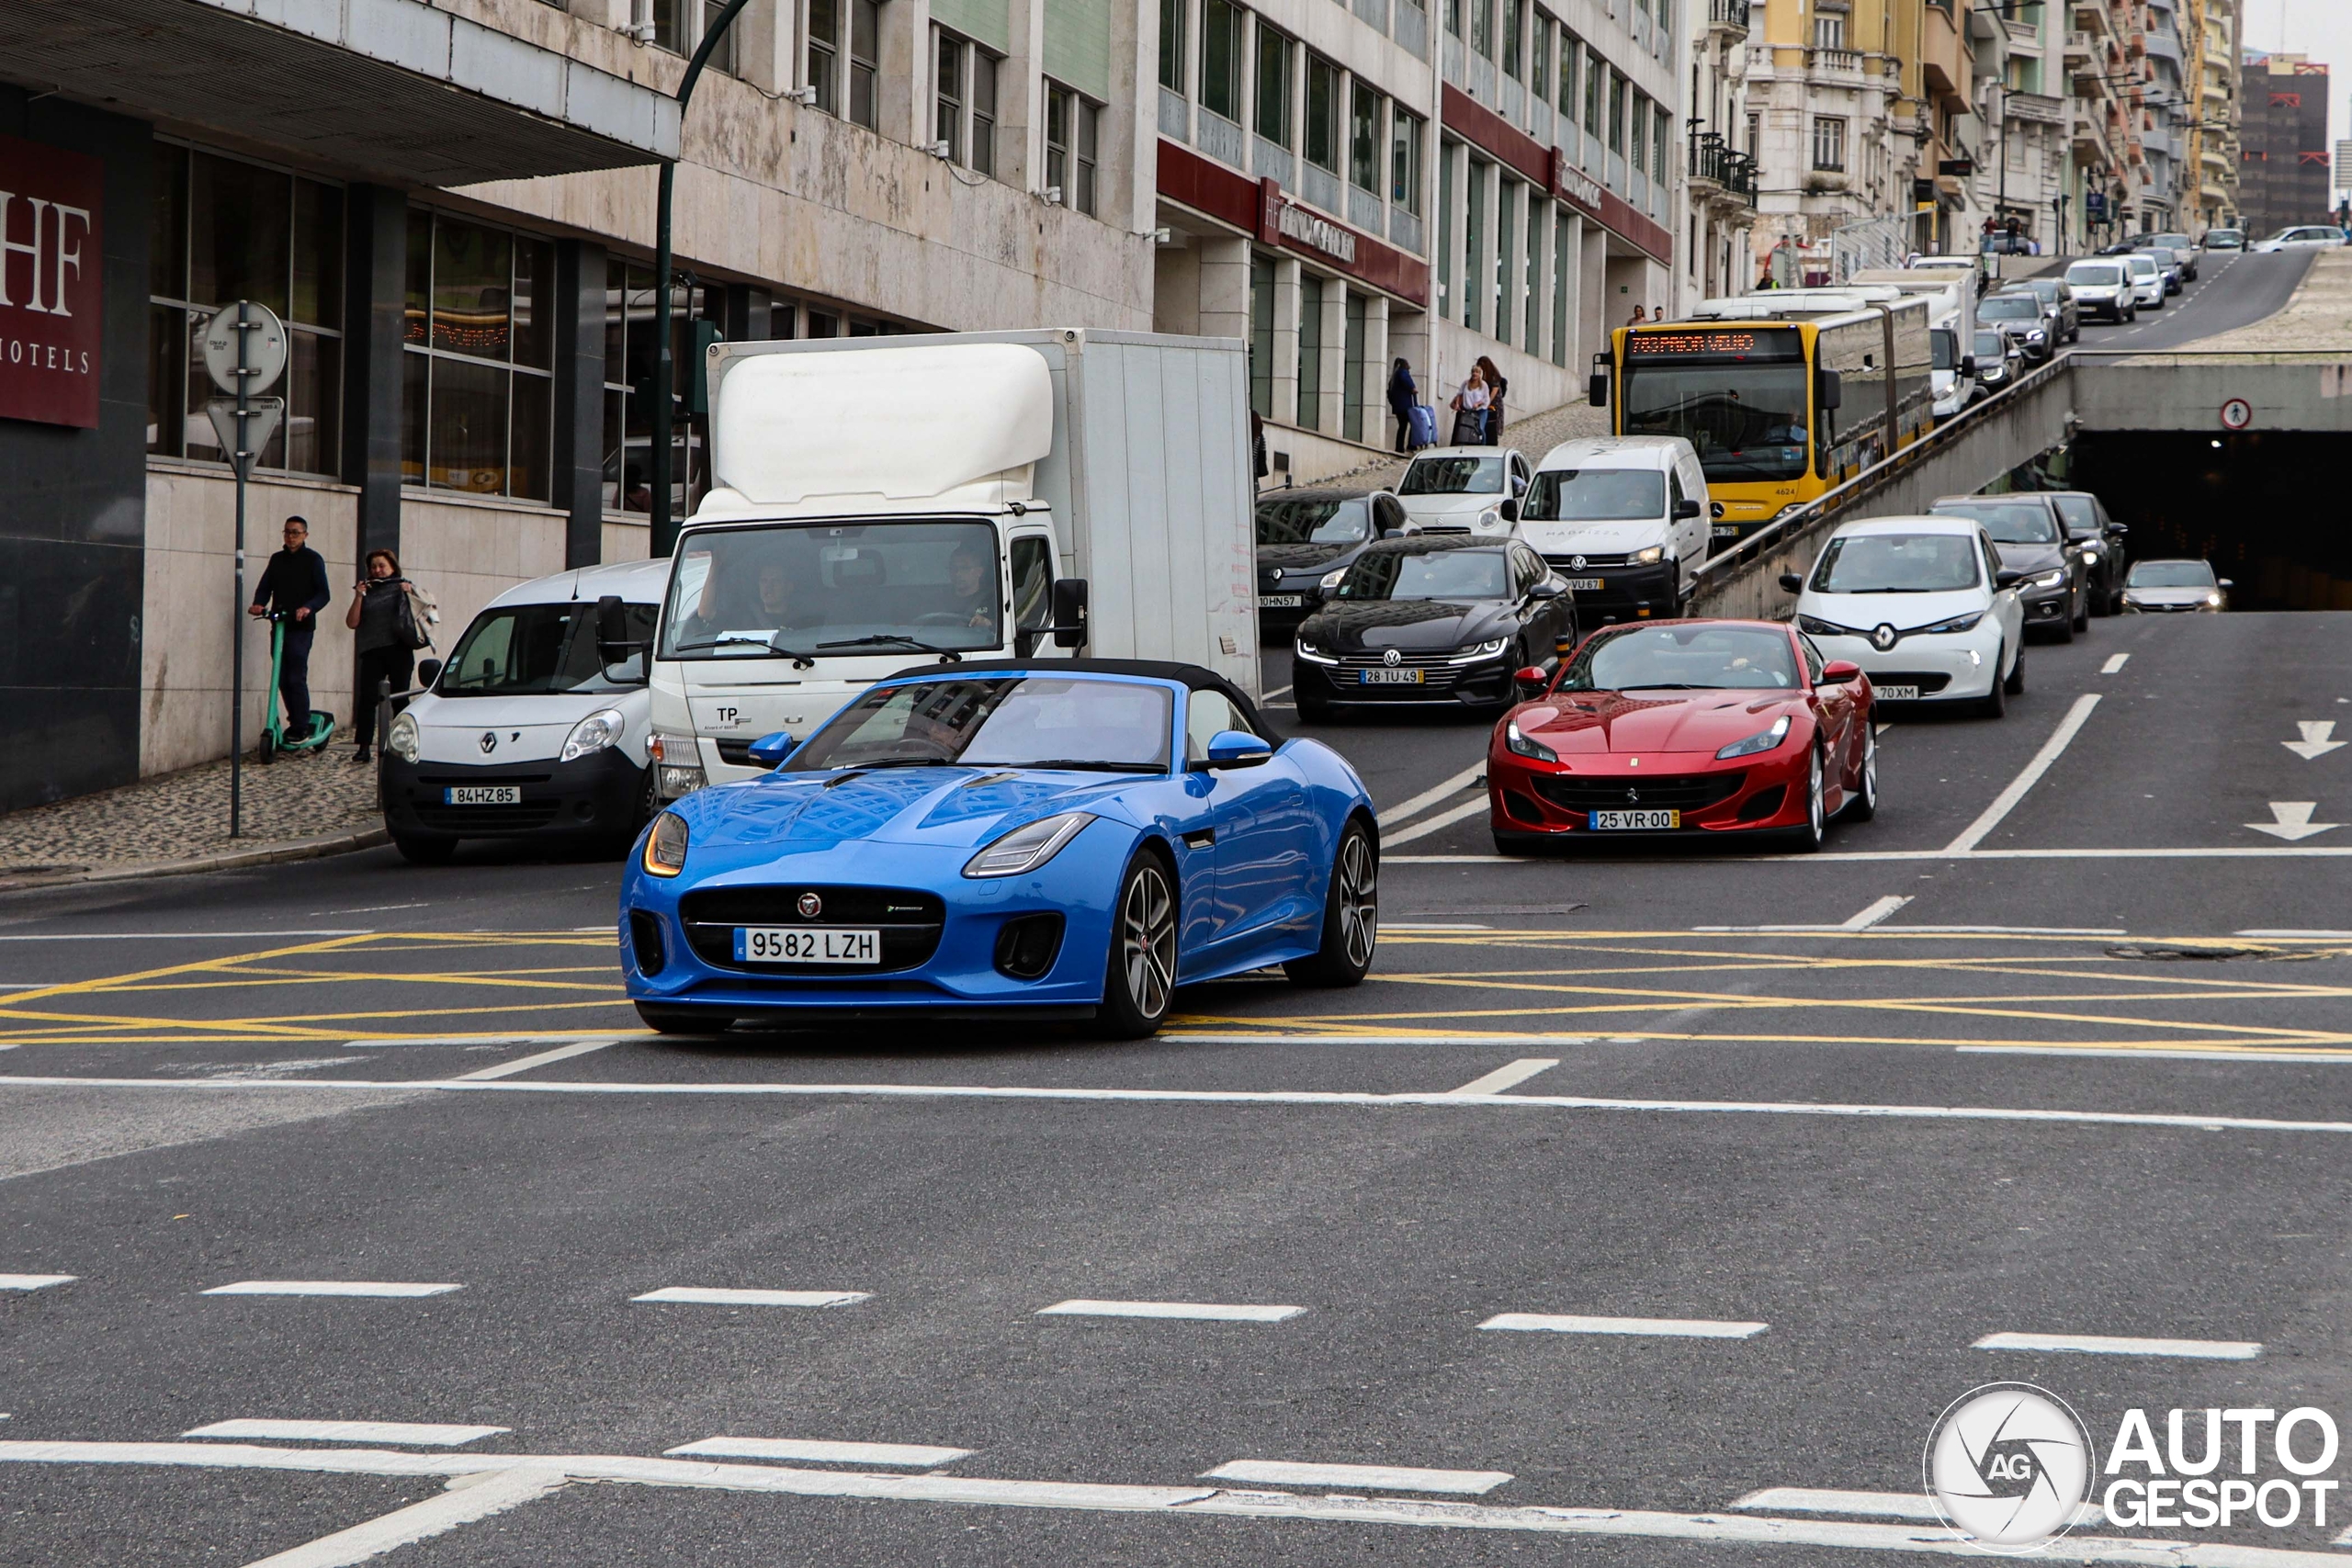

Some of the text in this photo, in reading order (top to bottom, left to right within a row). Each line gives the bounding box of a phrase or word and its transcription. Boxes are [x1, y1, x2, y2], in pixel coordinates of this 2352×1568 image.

[0, 190, 90, 317] HF
[0, 338, 88, 374] OTELS
[717, 708, 738, 721] TP
[752, 932, 816, 958] 9582
[826, 934, 873, 958] LZH
